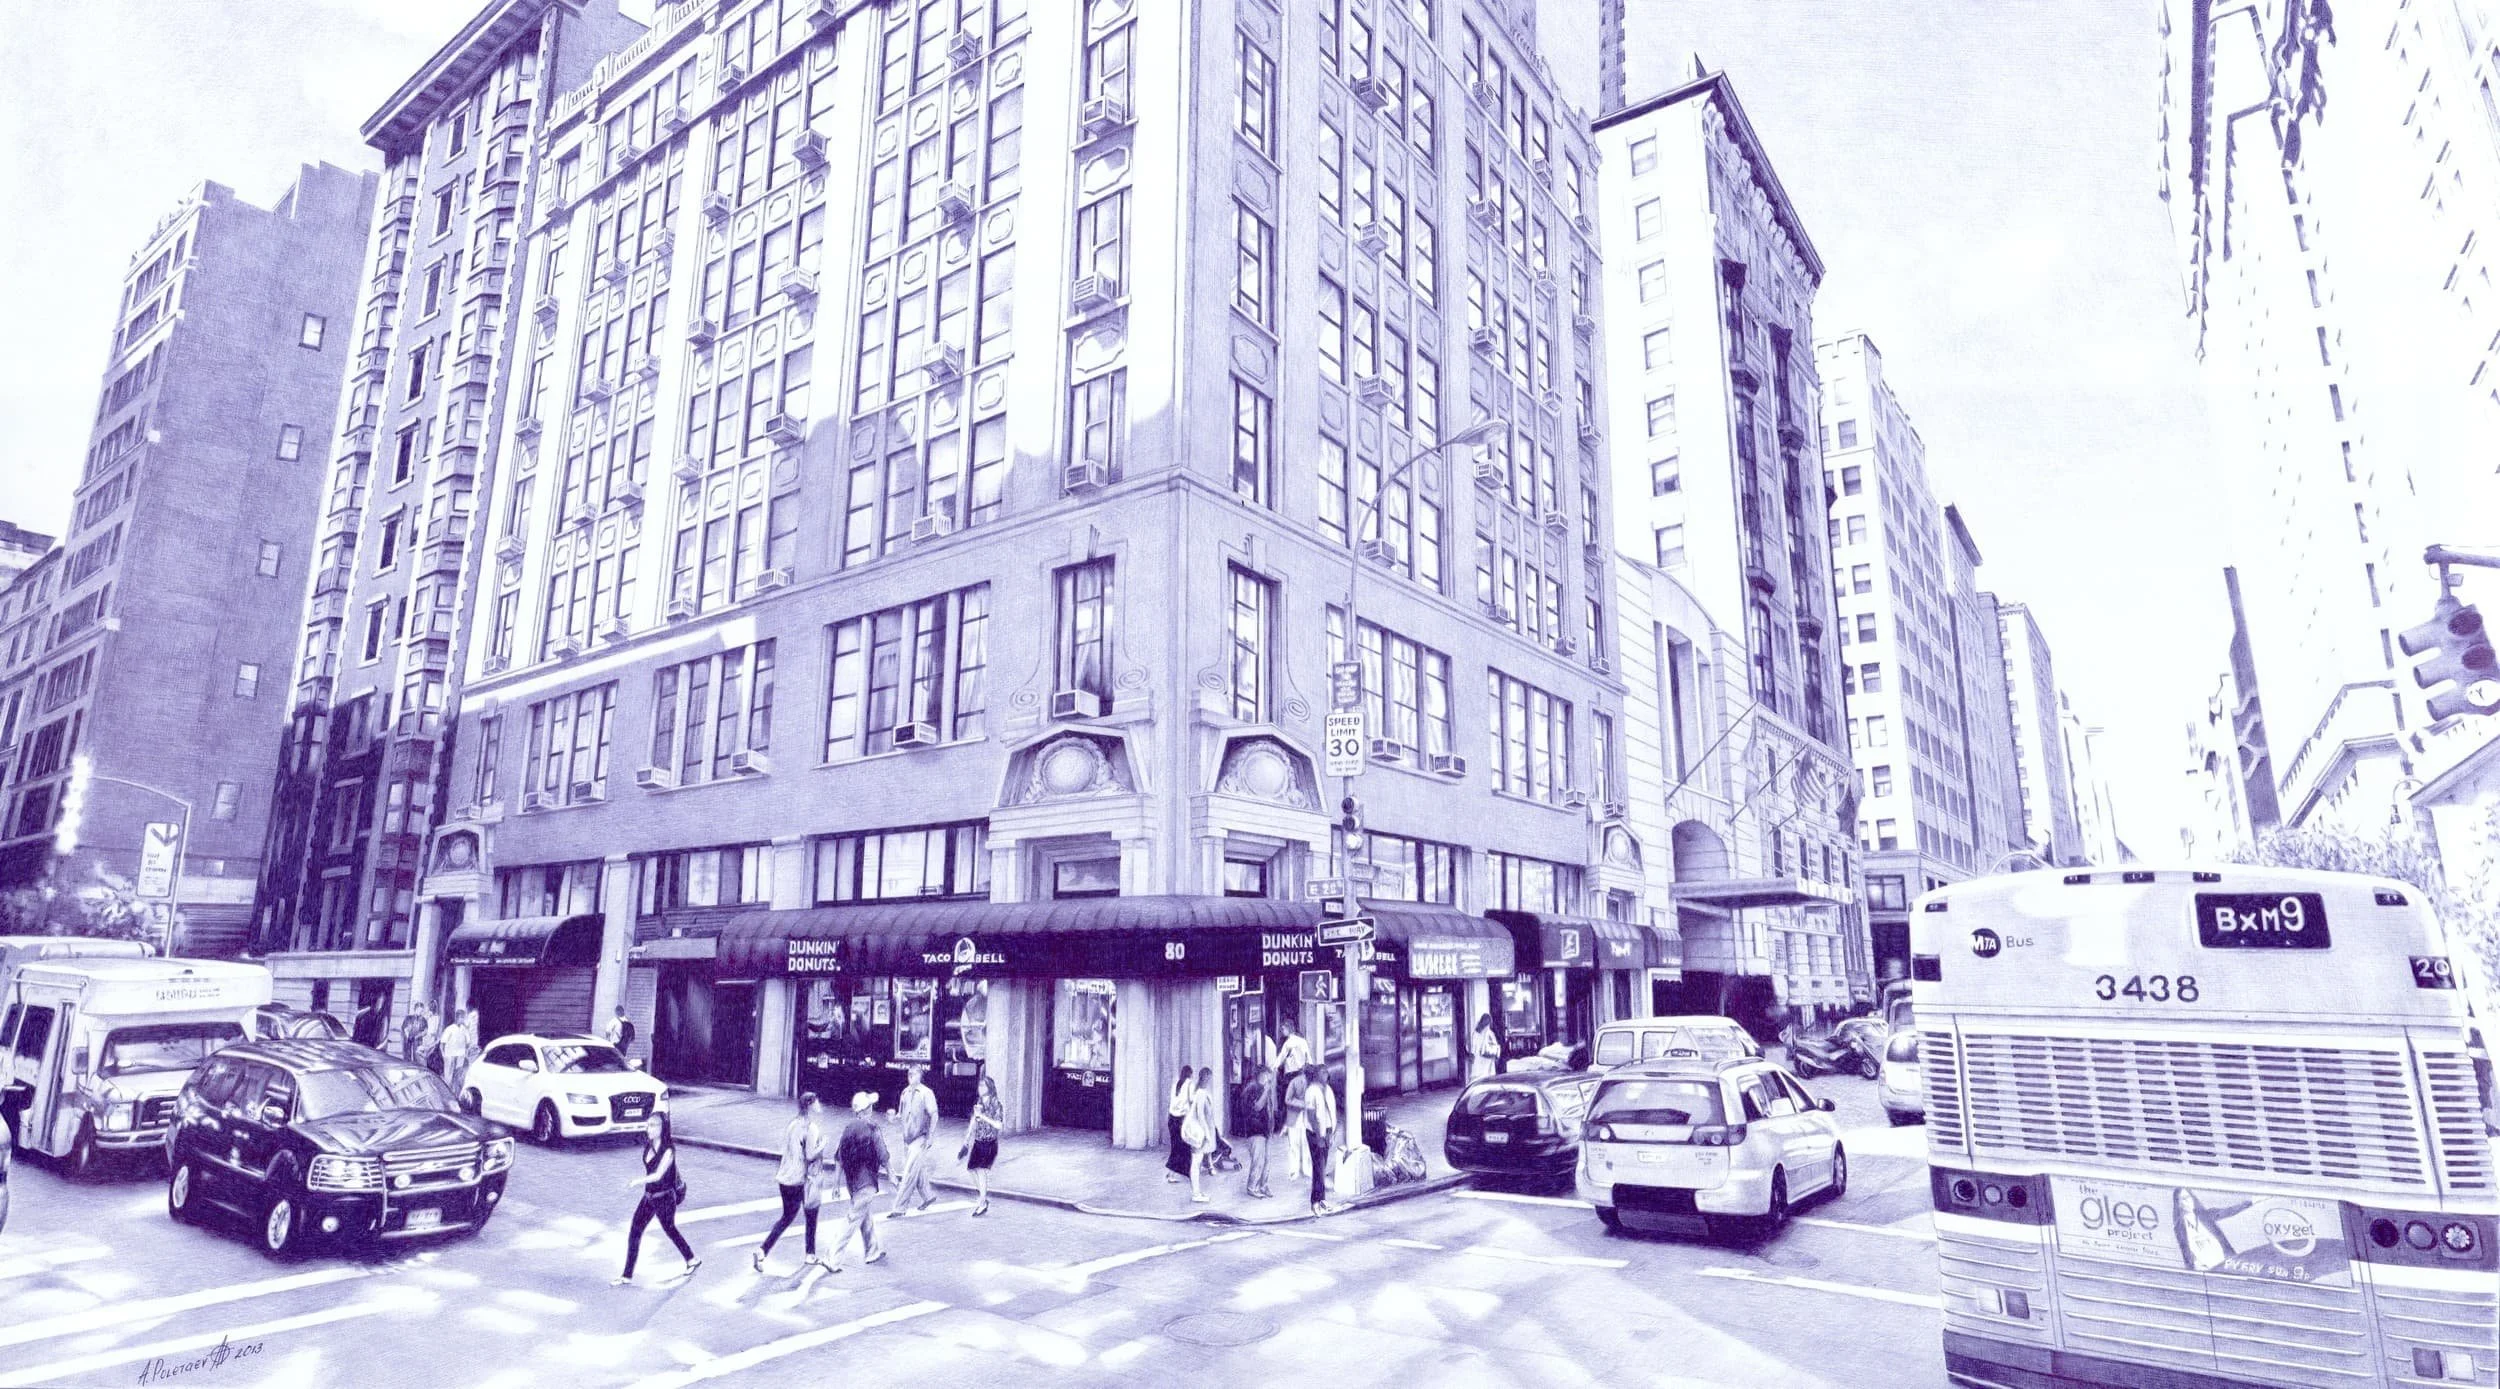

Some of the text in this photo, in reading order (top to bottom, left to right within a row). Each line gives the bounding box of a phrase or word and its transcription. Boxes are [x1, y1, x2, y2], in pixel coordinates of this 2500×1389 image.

[1328, 717, 1360, 726] SPEED
[1330, 728, 1357, 737] LIMIT
[1329, 739, 1360, 757] 30
[2215, 896, 2306, 932] BxM9
[788, 940, 840, 955] DUNKIN'
[1165, 942, 1185, 960] 80
[1970, 935, 2034, 951] MTA Bus
[922, 953, 1005, 963] TACO BELL
[1262, 951, 1314, 966] DONUTS
[2095, 974, 2200, 1002] 3438
[2080, 1195, 2159, 1230] glee
[234, 1343, 263, 1359] 2013
